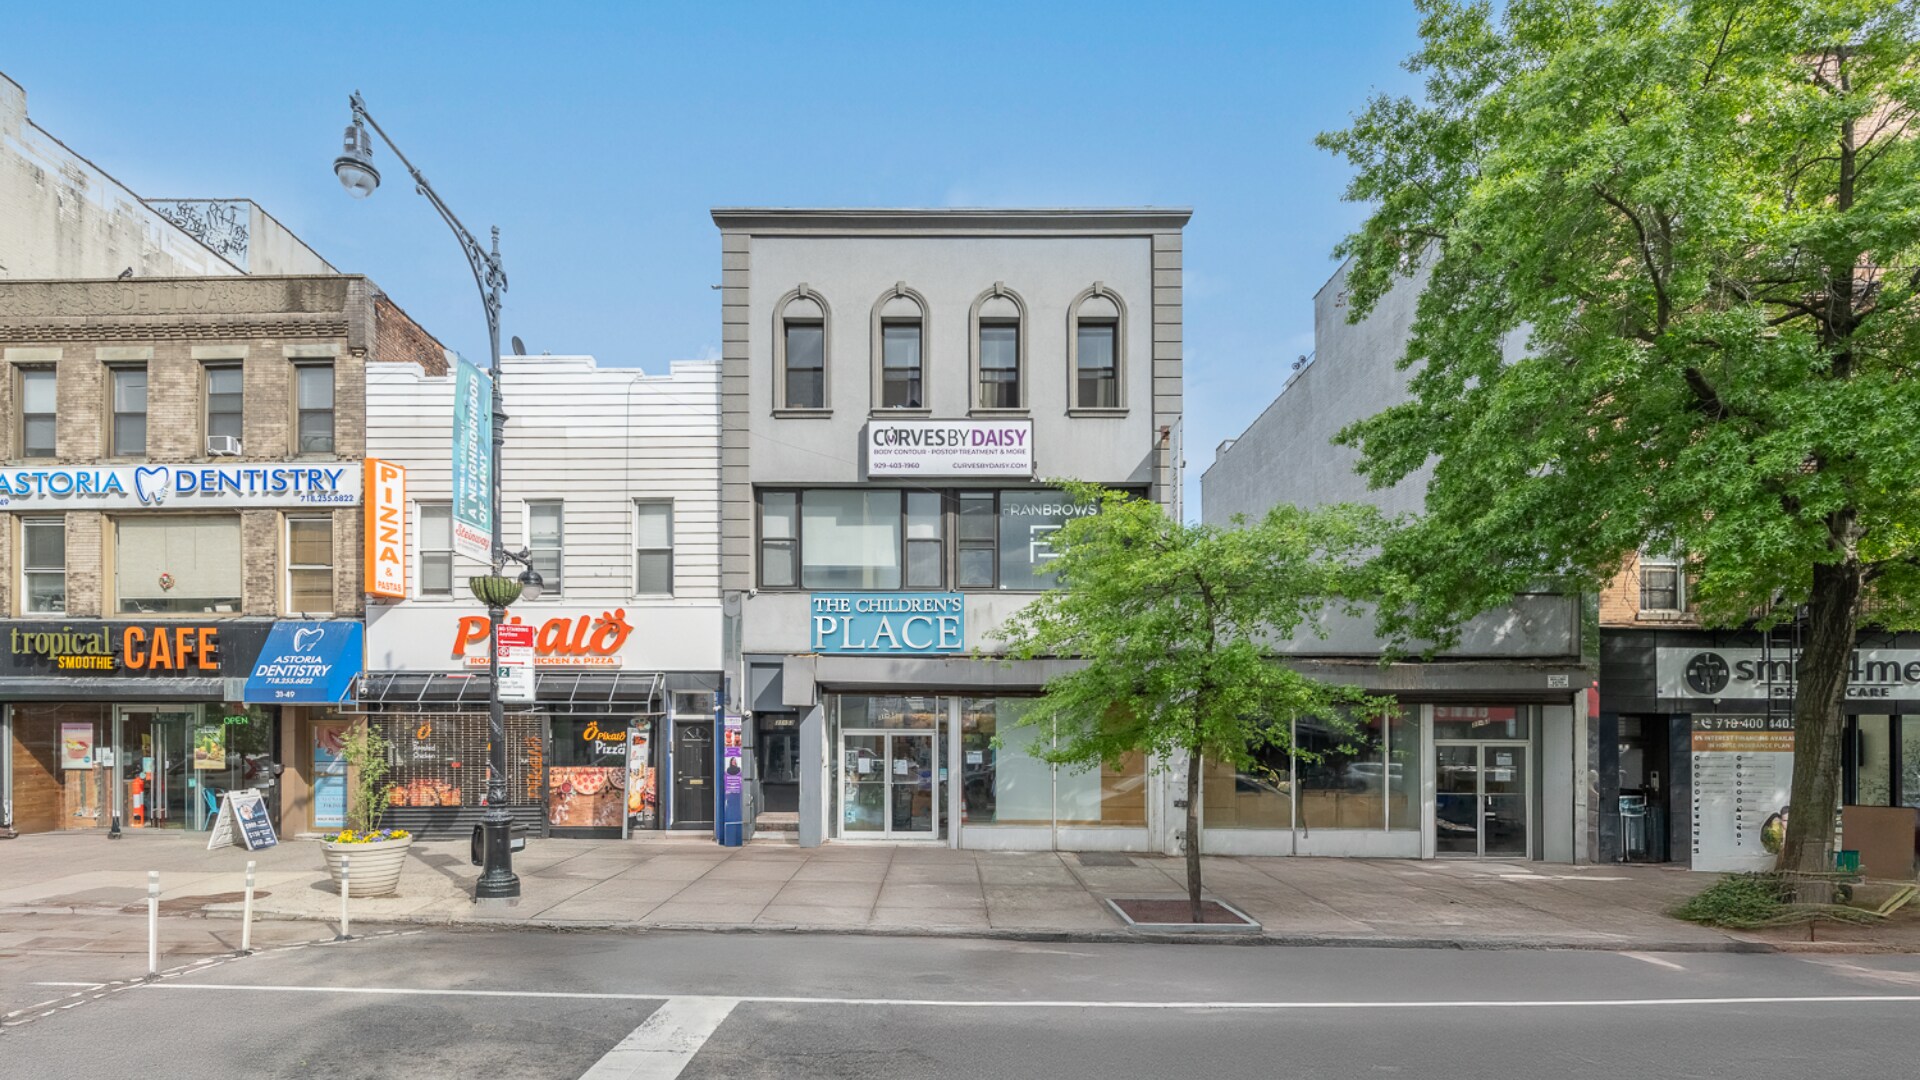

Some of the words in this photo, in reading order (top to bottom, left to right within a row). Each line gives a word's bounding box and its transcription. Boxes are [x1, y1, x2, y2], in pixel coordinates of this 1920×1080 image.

[467, 374, 478, 503] NEIGHBORHOOD
[873, 427, 945, 447] CURVES
[947, 429, 970, 447] BY
[971, 429, 1027, 447] DAISY
[0, 471, 124, 494] ASTORIA
[175, 468, 345, 492] DENTISTRY
[479, 448, 488, 498] MANY
[379, 466, 400, 564] PIZZA
[468, 508, 477, 520] A
[479, 501, 488, 523] OF
[1003, 502, 1098, 517] FRANBROWS
[455, 524, 490, 550] Steinway
[385, 567, 393, 577] &
[378, 580, 402, 593] PASTAS
[813, 597, 851, 613] THE
[855, 596, 962, 614] CHILDREN'S
[812, 614, 962, 650] PLACE
[10, 626, 113, 661] tropical
[123, 625, 219, 670] CAFE
[58, 656, 114, 670] SMOOTHIE
[273, 655, 323, 664] ASTORIA
[572, 656, 581, 665] &
[583, 656, 615, 665] PIZZA
[1735, 650, 1920, 683] smi4me
[256, 664, 333, 677] DENTISTRY
[1845, 686, 1890, 697] CARE
[223, 716, 248, 725] OPEN
